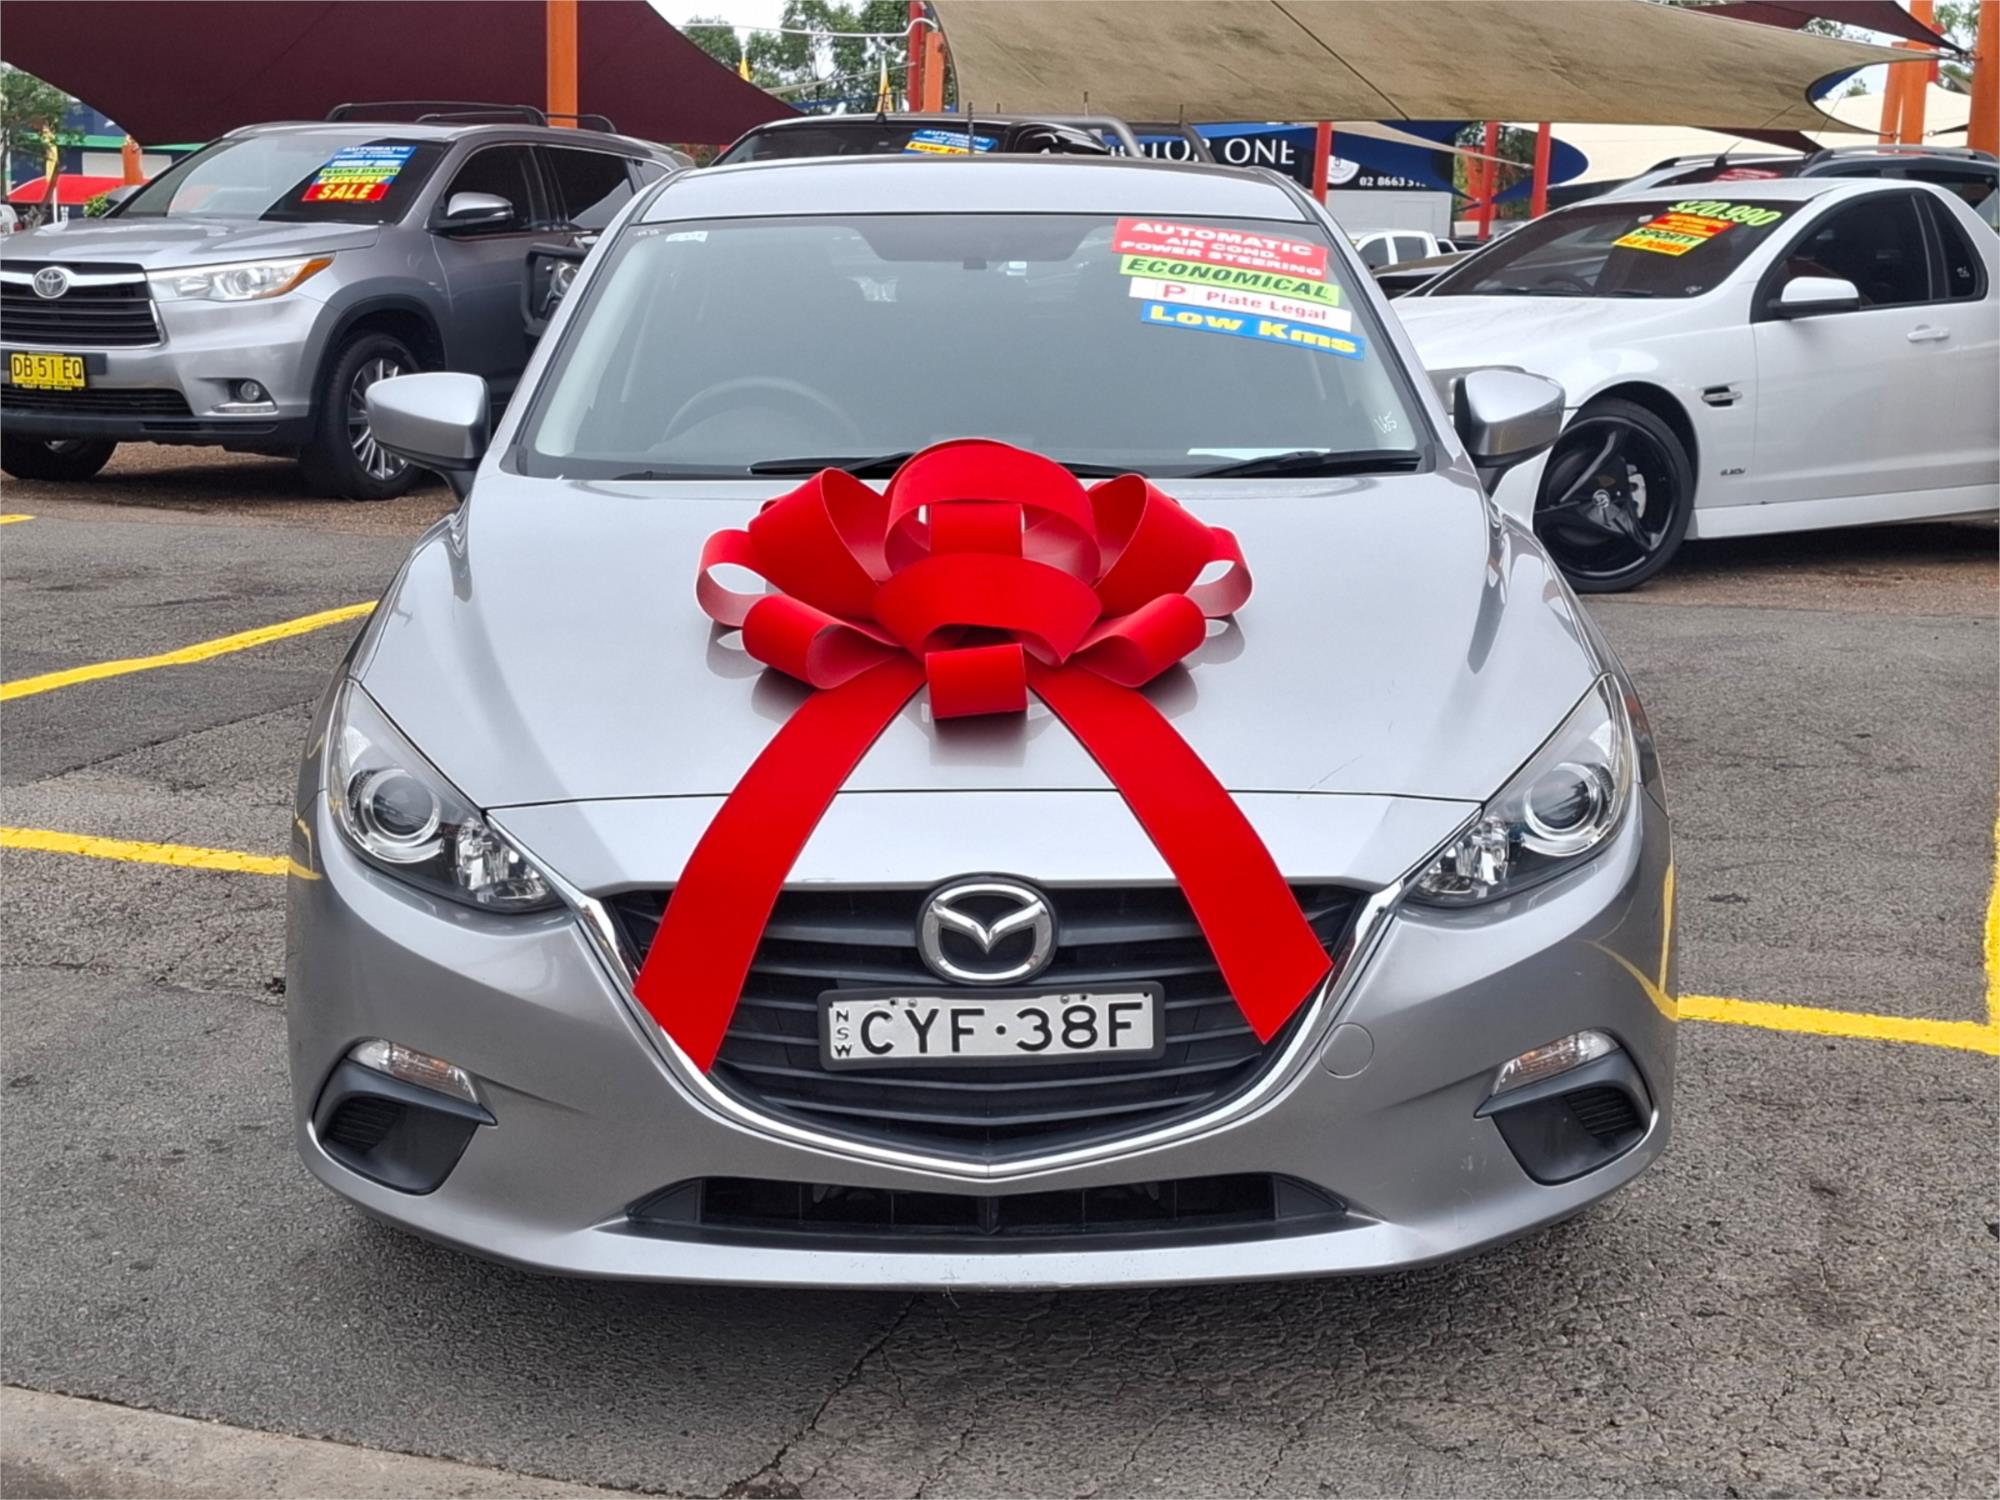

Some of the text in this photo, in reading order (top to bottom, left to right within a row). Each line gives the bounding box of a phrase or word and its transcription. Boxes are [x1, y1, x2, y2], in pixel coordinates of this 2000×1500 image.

[1224, 138, 1295, 164] ONE
[318, 175, 389, 184] LUXURY
[318, 184, 375, 199] SALE
[1359, 176, 1374, 187] 02
[1131, 221, 1312, 257] AUTOMATIC
[1166, 236, 1280, 260] AIR COND.
[1120, 240, 1323, 277] POWER STEERING
[1127, 258, 1330, 300] ECONOMICAL
[1163, 283, 1328, 321] P Plate Legal
